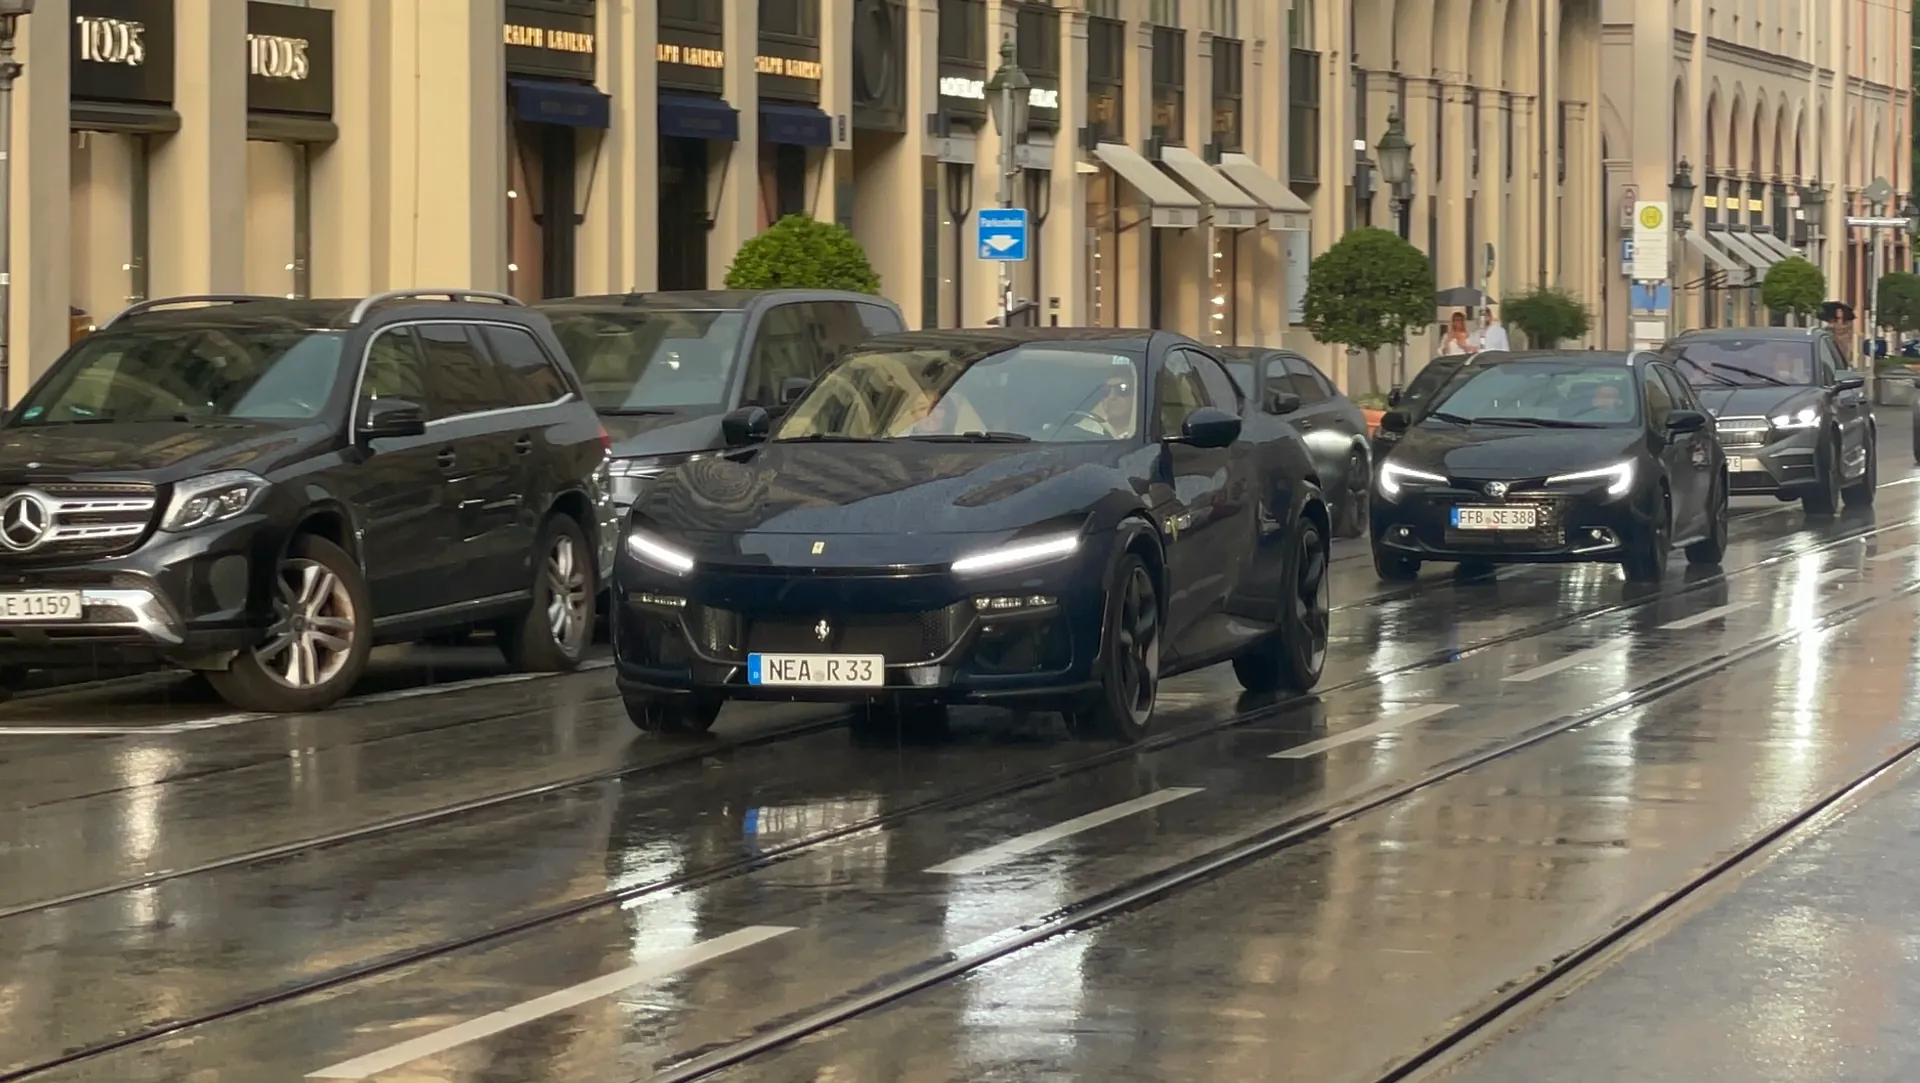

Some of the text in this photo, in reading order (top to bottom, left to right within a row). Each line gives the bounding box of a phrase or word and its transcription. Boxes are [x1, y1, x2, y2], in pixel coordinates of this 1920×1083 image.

[1459, 510, 1535, 524] FFB SE 388
[6, 596, 71, 616] E 1159
[769, 659, 811, 680] NEA
[827, 660, 840, 681] R
[846, 660, 873, 681] 33
